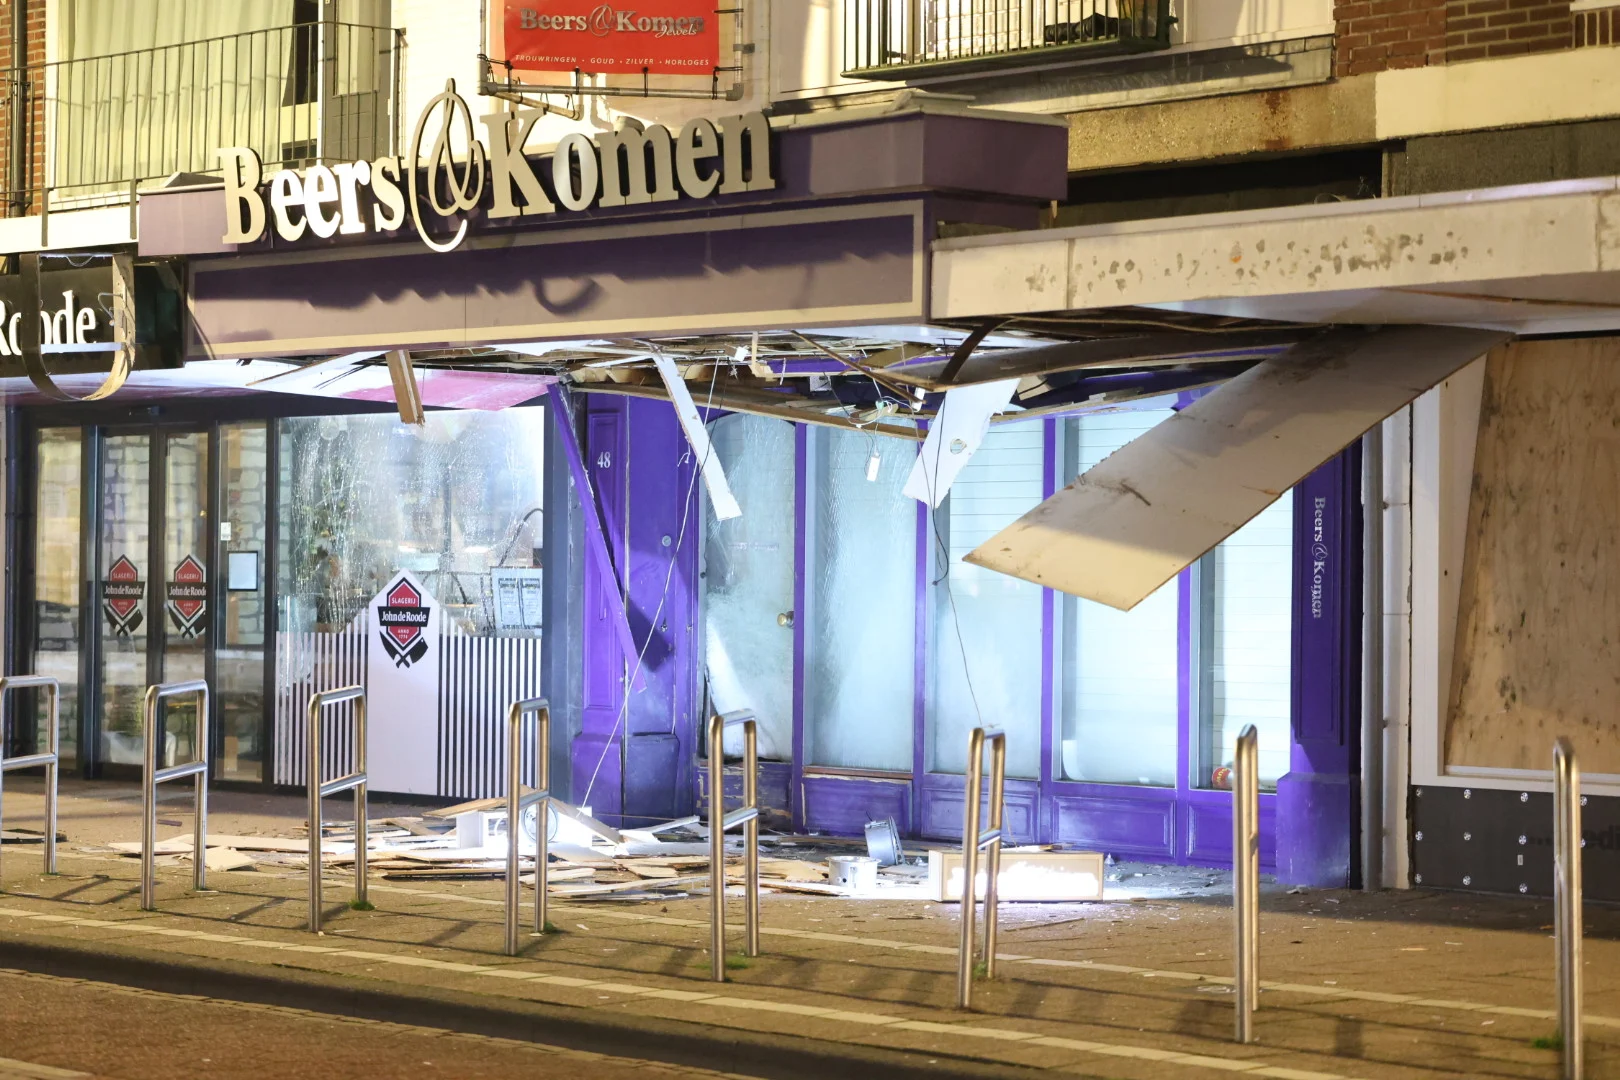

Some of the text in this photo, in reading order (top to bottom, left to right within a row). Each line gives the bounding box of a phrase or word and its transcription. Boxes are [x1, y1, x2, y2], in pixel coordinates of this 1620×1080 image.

[519, 8, 588, 31] Beers
[615, 10, 705, 33] Komen
[655, 23, 698, 38] Jewels
[515, 54, 577, 63] TROUWRINGEN
[590, 57, 615, 65] GOUD
[664, 58, 710, 66] HORLOGES
[215, 145, 402, 244] Beers
[480, 110, 776, 220] Komen
[597, 451, 611, 469] 48
[1313, 496, 1326, 542] Beers
[1313, 560, 1326, 619] Komen
[382, 611, 427, 622] John de Roode
